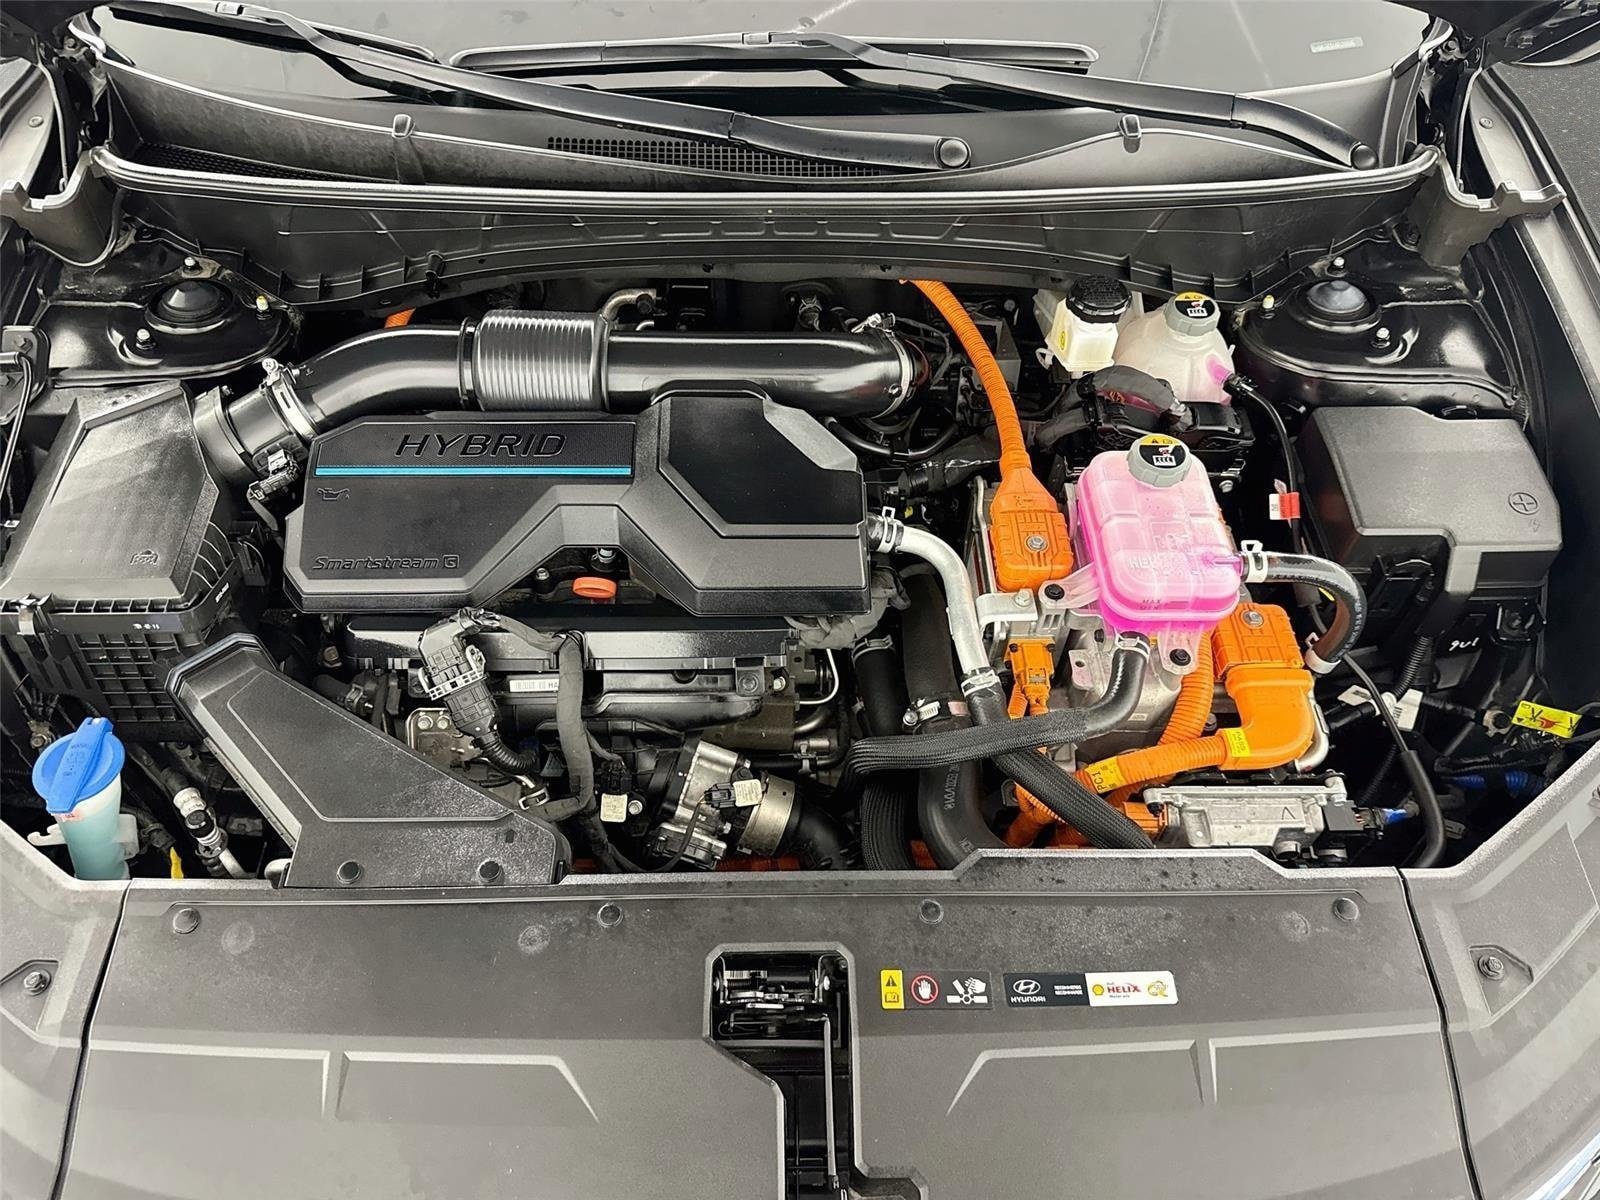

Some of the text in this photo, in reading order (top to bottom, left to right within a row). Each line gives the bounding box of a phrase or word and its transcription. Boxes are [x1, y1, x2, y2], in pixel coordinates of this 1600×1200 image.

[394, 433, 567, 458] HYBRID
[312, 556, 438, 571] Smartstream
[1107, 984, 1141, 993] HELIX
